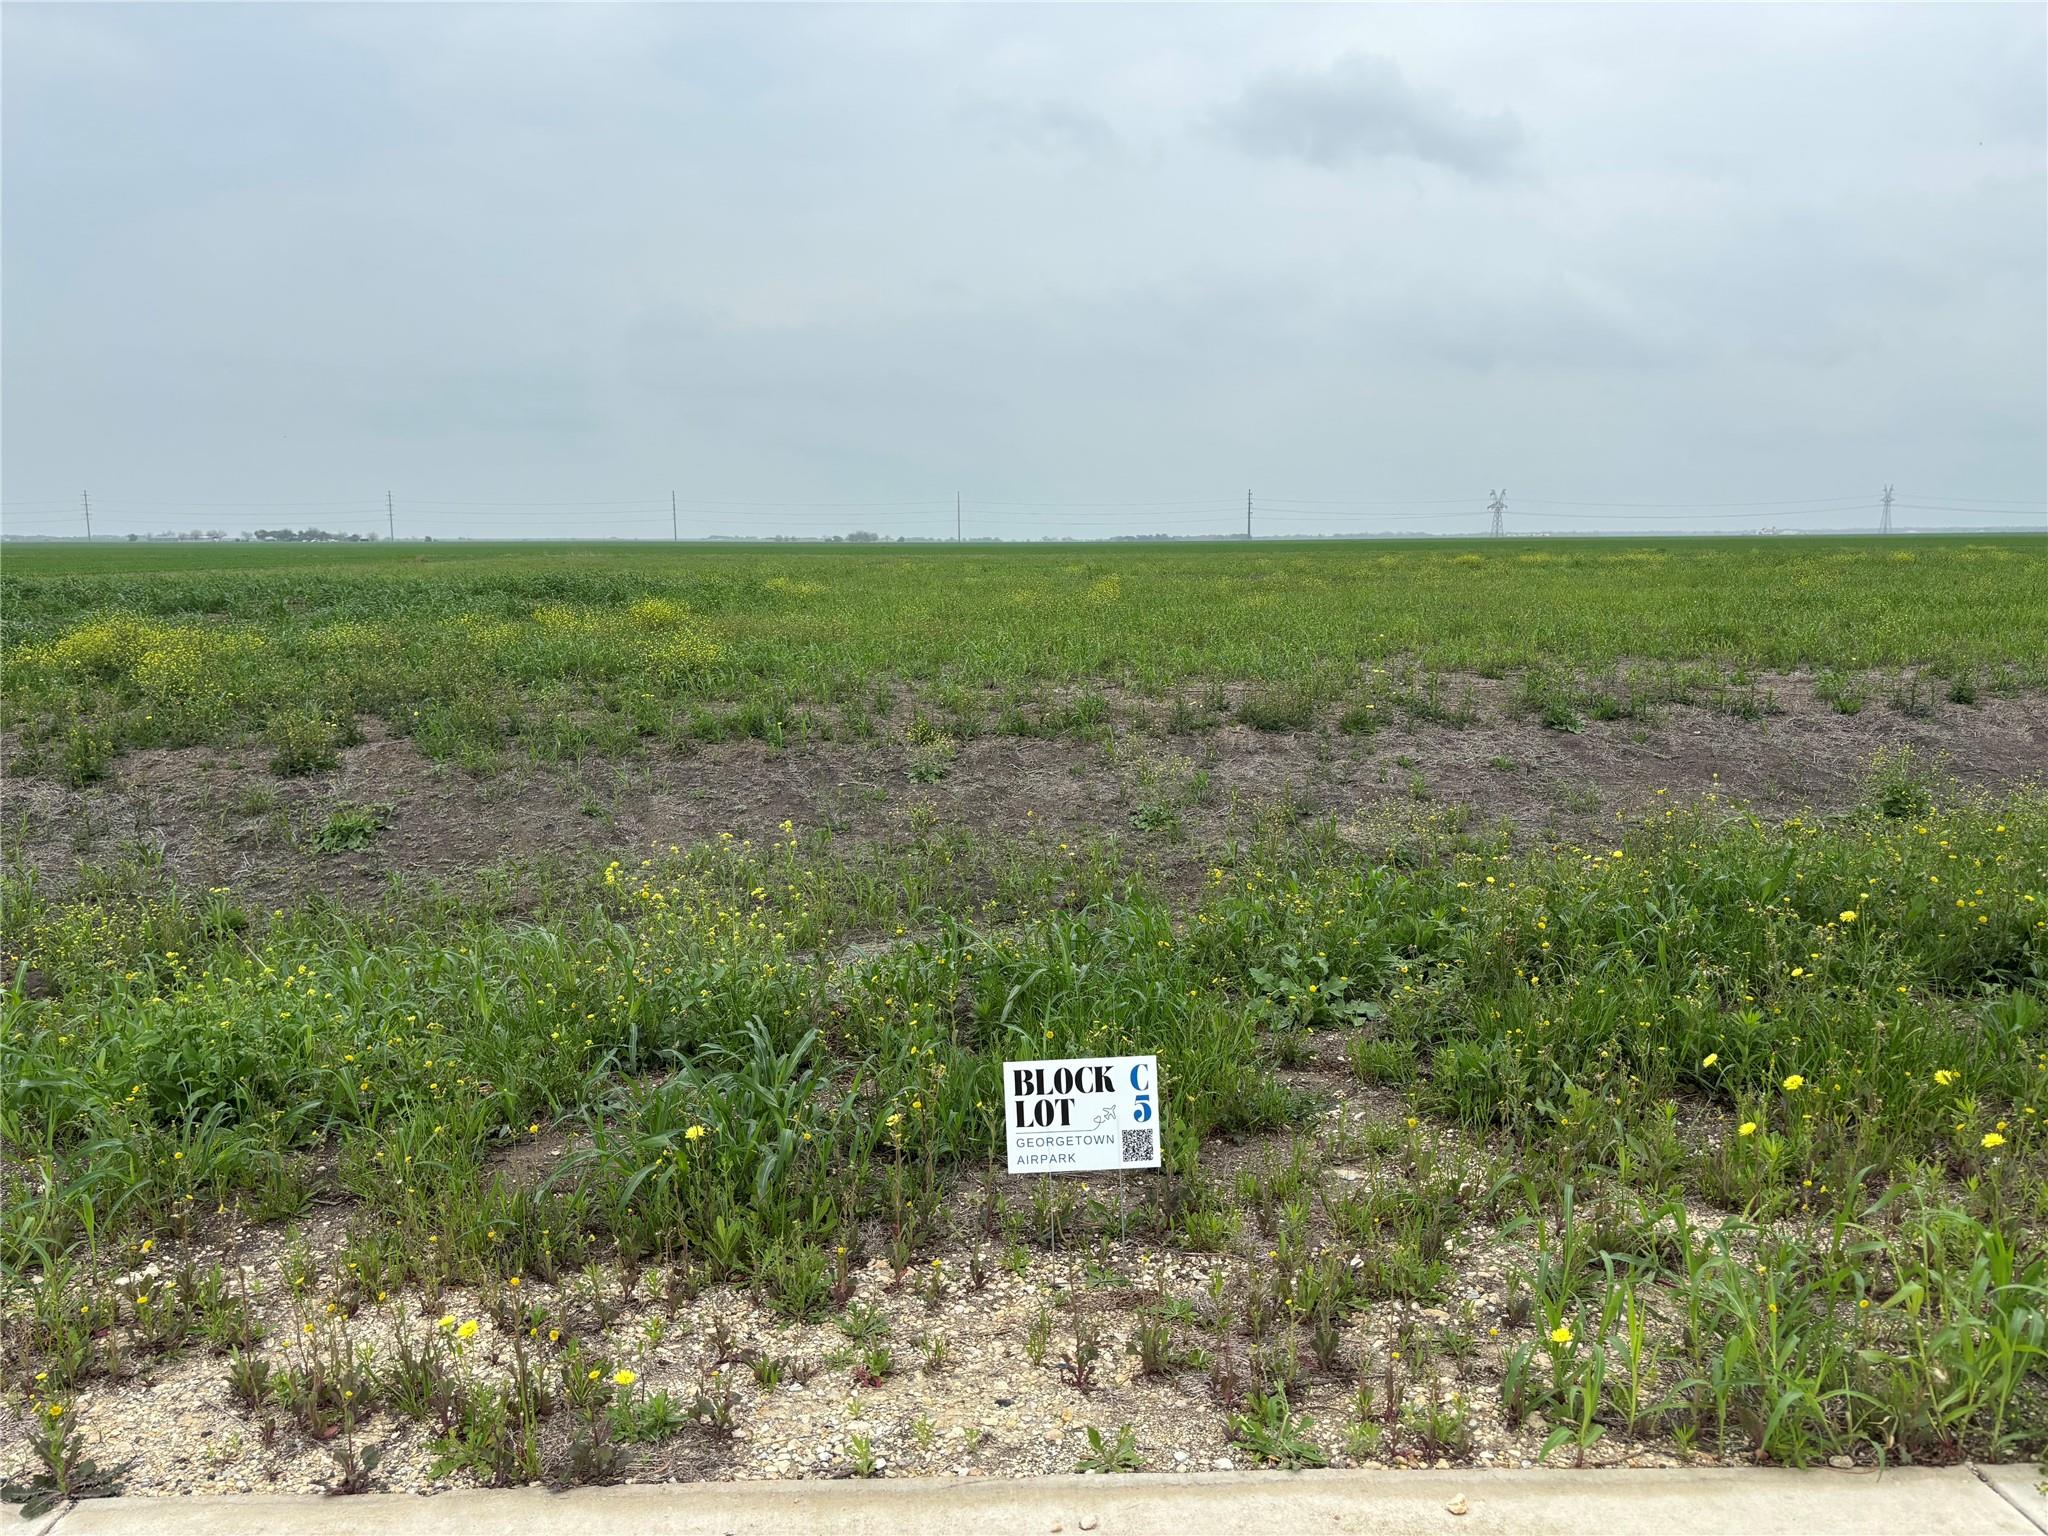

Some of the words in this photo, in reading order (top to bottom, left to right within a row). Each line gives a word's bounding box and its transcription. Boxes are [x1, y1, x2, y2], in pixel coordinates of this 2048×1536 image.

[1013, 1066, 1115, 1096] BLOCK
[1130, 1064, 1149, 1091] C
[1015, 1098, 1075, 1128] LOT
[1133, 1095, 1152, 1122] 5
[1016, 1135, 1115, 1148] GEORGETOWN
[1017, 1153, 1076, 1165] AIRPARK
